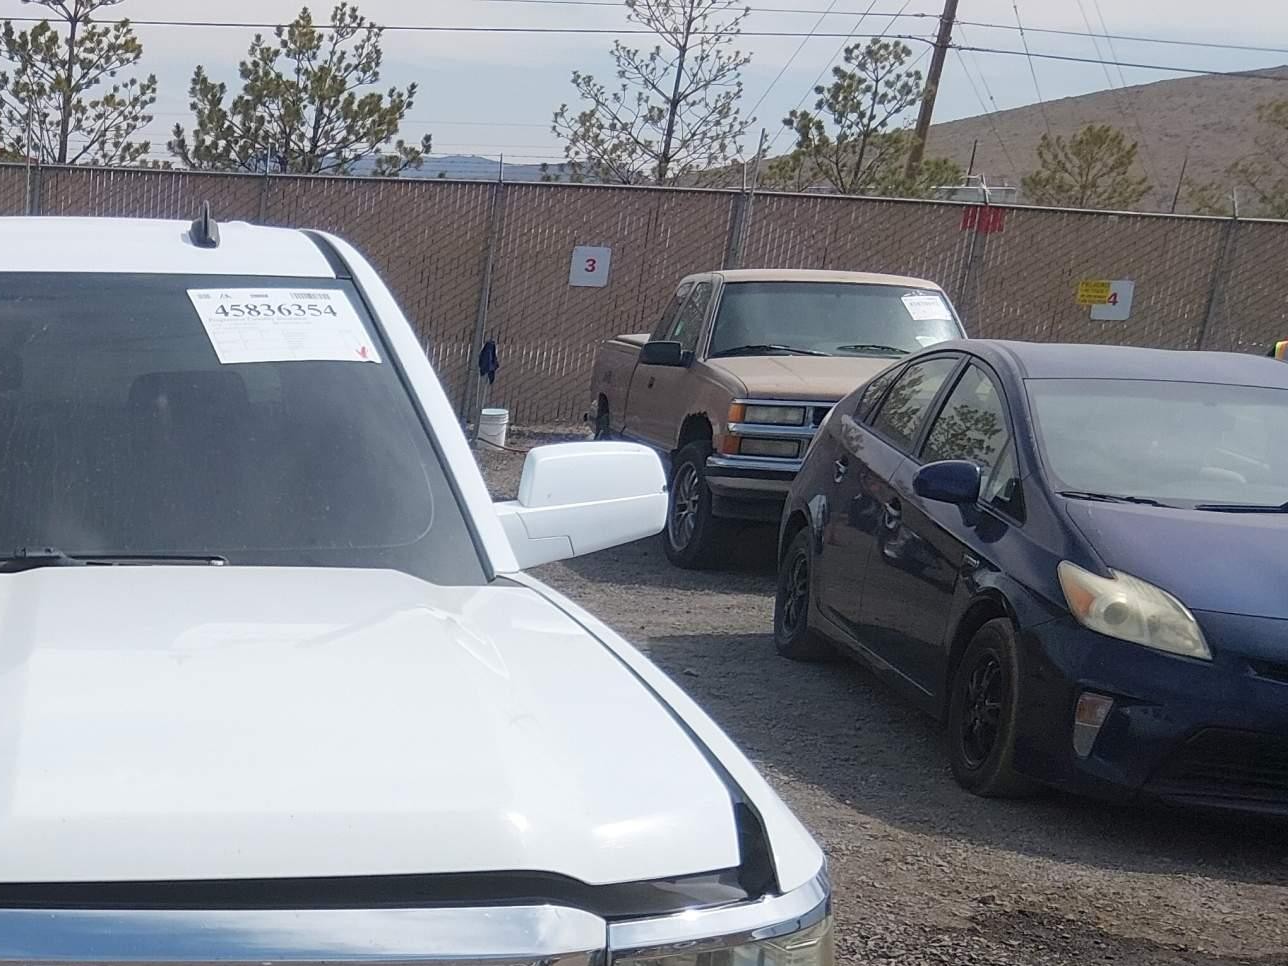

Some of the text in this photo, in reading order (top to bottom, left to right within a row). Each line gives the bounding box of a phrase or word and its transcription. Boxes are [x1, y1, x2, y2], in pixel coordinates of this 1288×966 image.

[584, 258, 597, 273] 3
[1107, 291, 1119, 306] 4
[214, 303, 338, 318] 45836354
